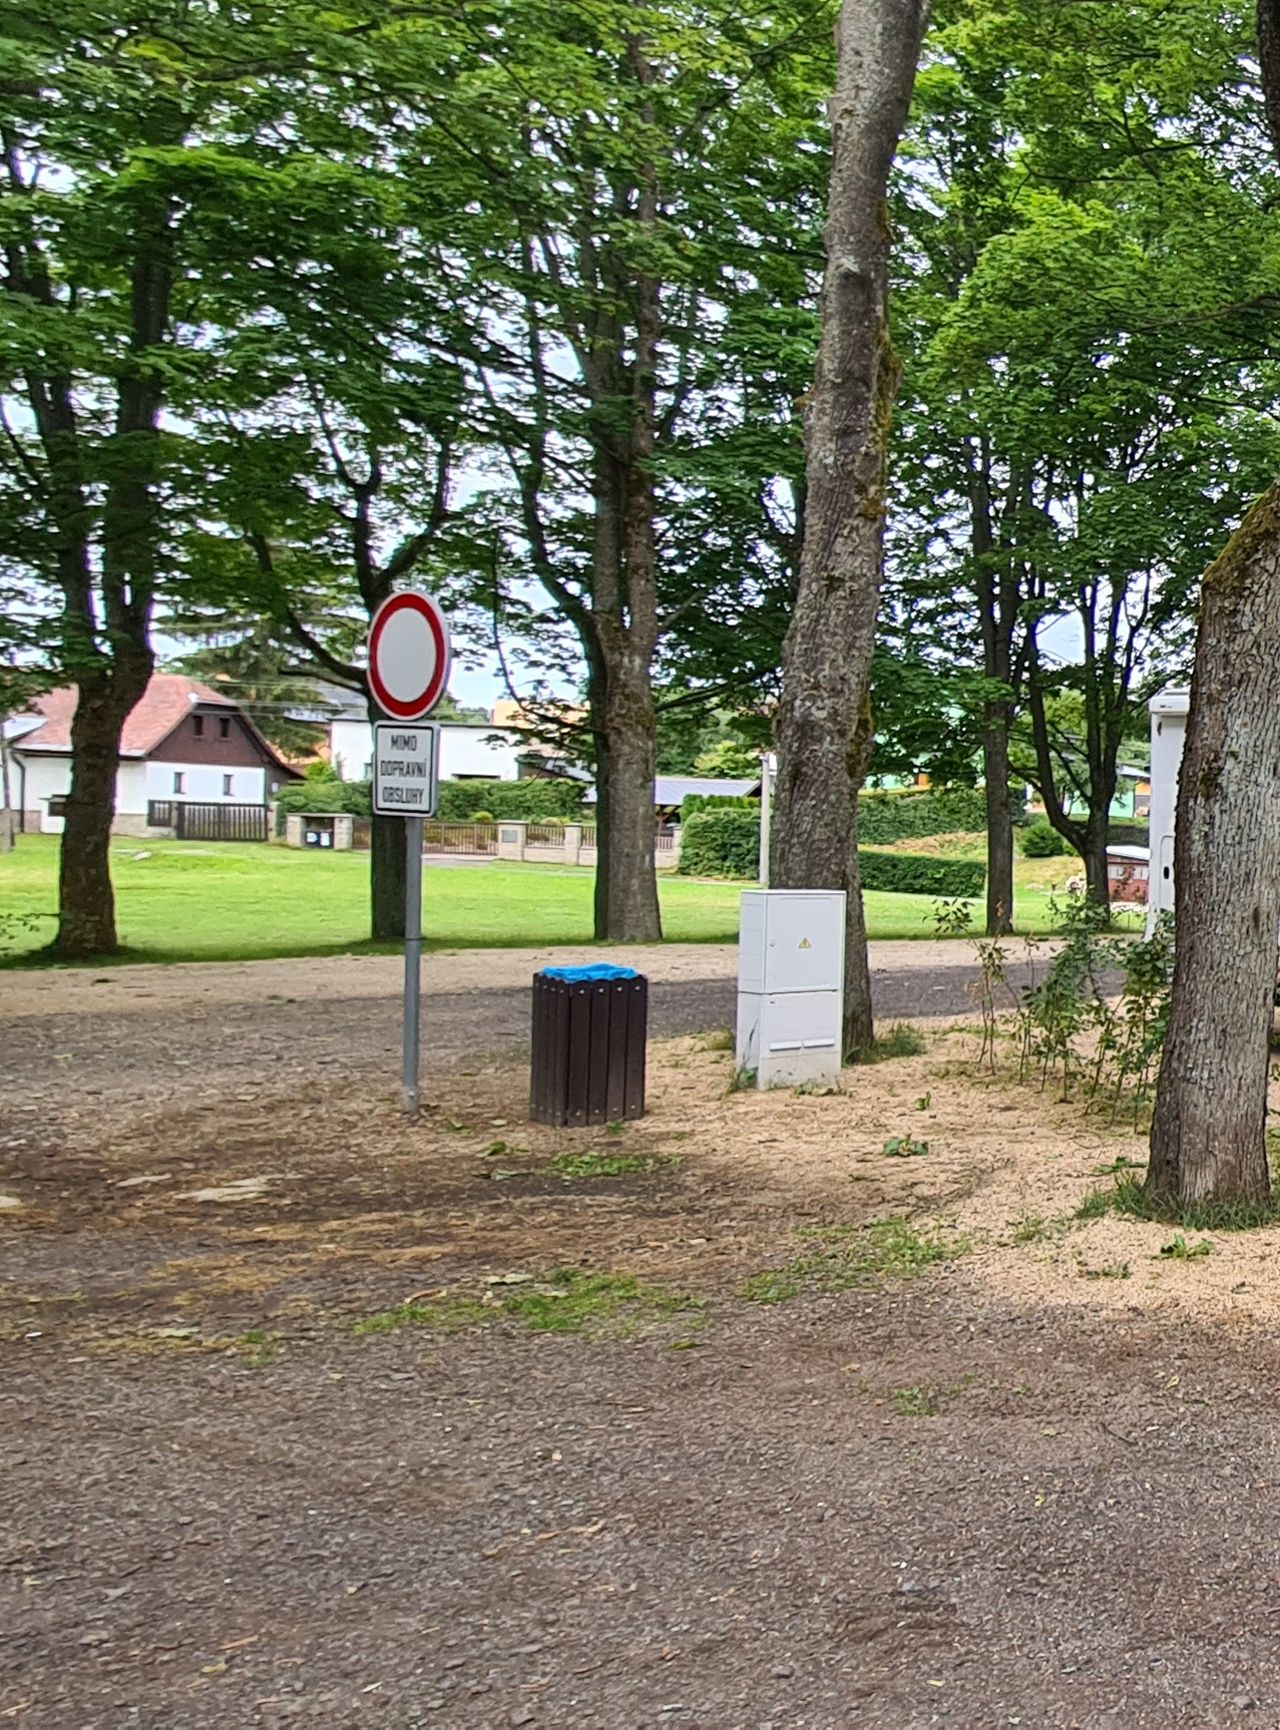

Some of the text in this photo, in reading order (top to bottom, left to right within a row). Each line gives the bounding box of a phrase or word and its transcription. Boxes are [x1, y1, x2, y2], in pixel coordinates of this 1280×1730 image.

[391, 734, 417, 752] MIMO
[380, 758, 427, 778] DOPRAVNÍ
[382, 786, 425, 805] OBSLUHY
